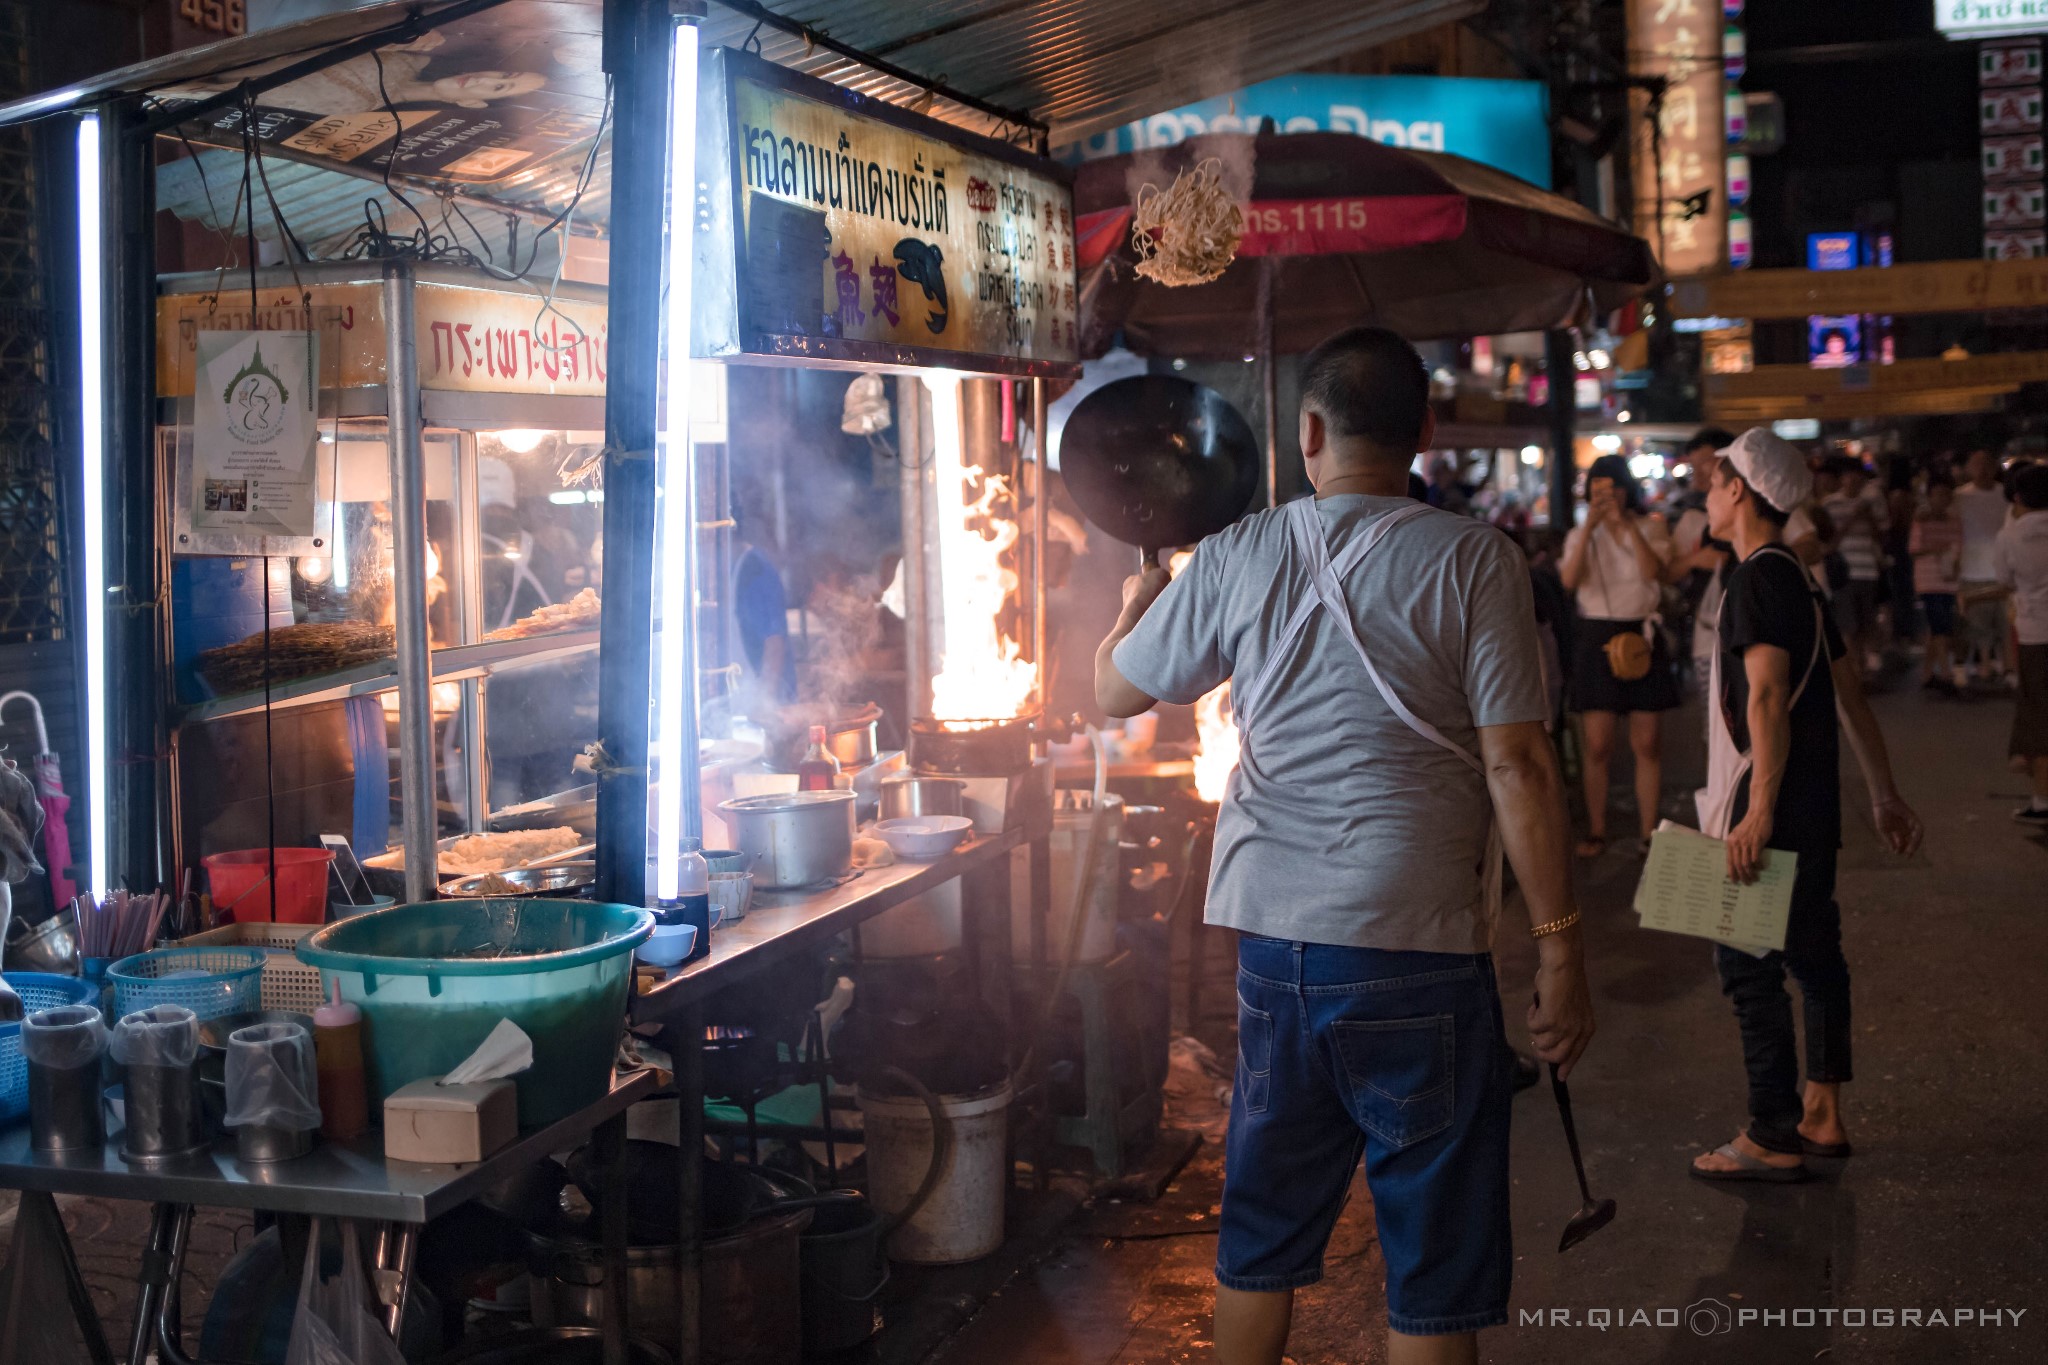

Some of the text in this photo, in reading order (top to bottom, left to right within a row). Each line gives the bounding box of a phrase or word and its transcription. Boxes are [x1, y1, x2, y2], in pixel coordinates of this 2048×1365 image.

[181, 0, 245, 35] 456
[743, 123, 949, 234] หฉลามน้ำแดงบรั่นดี
